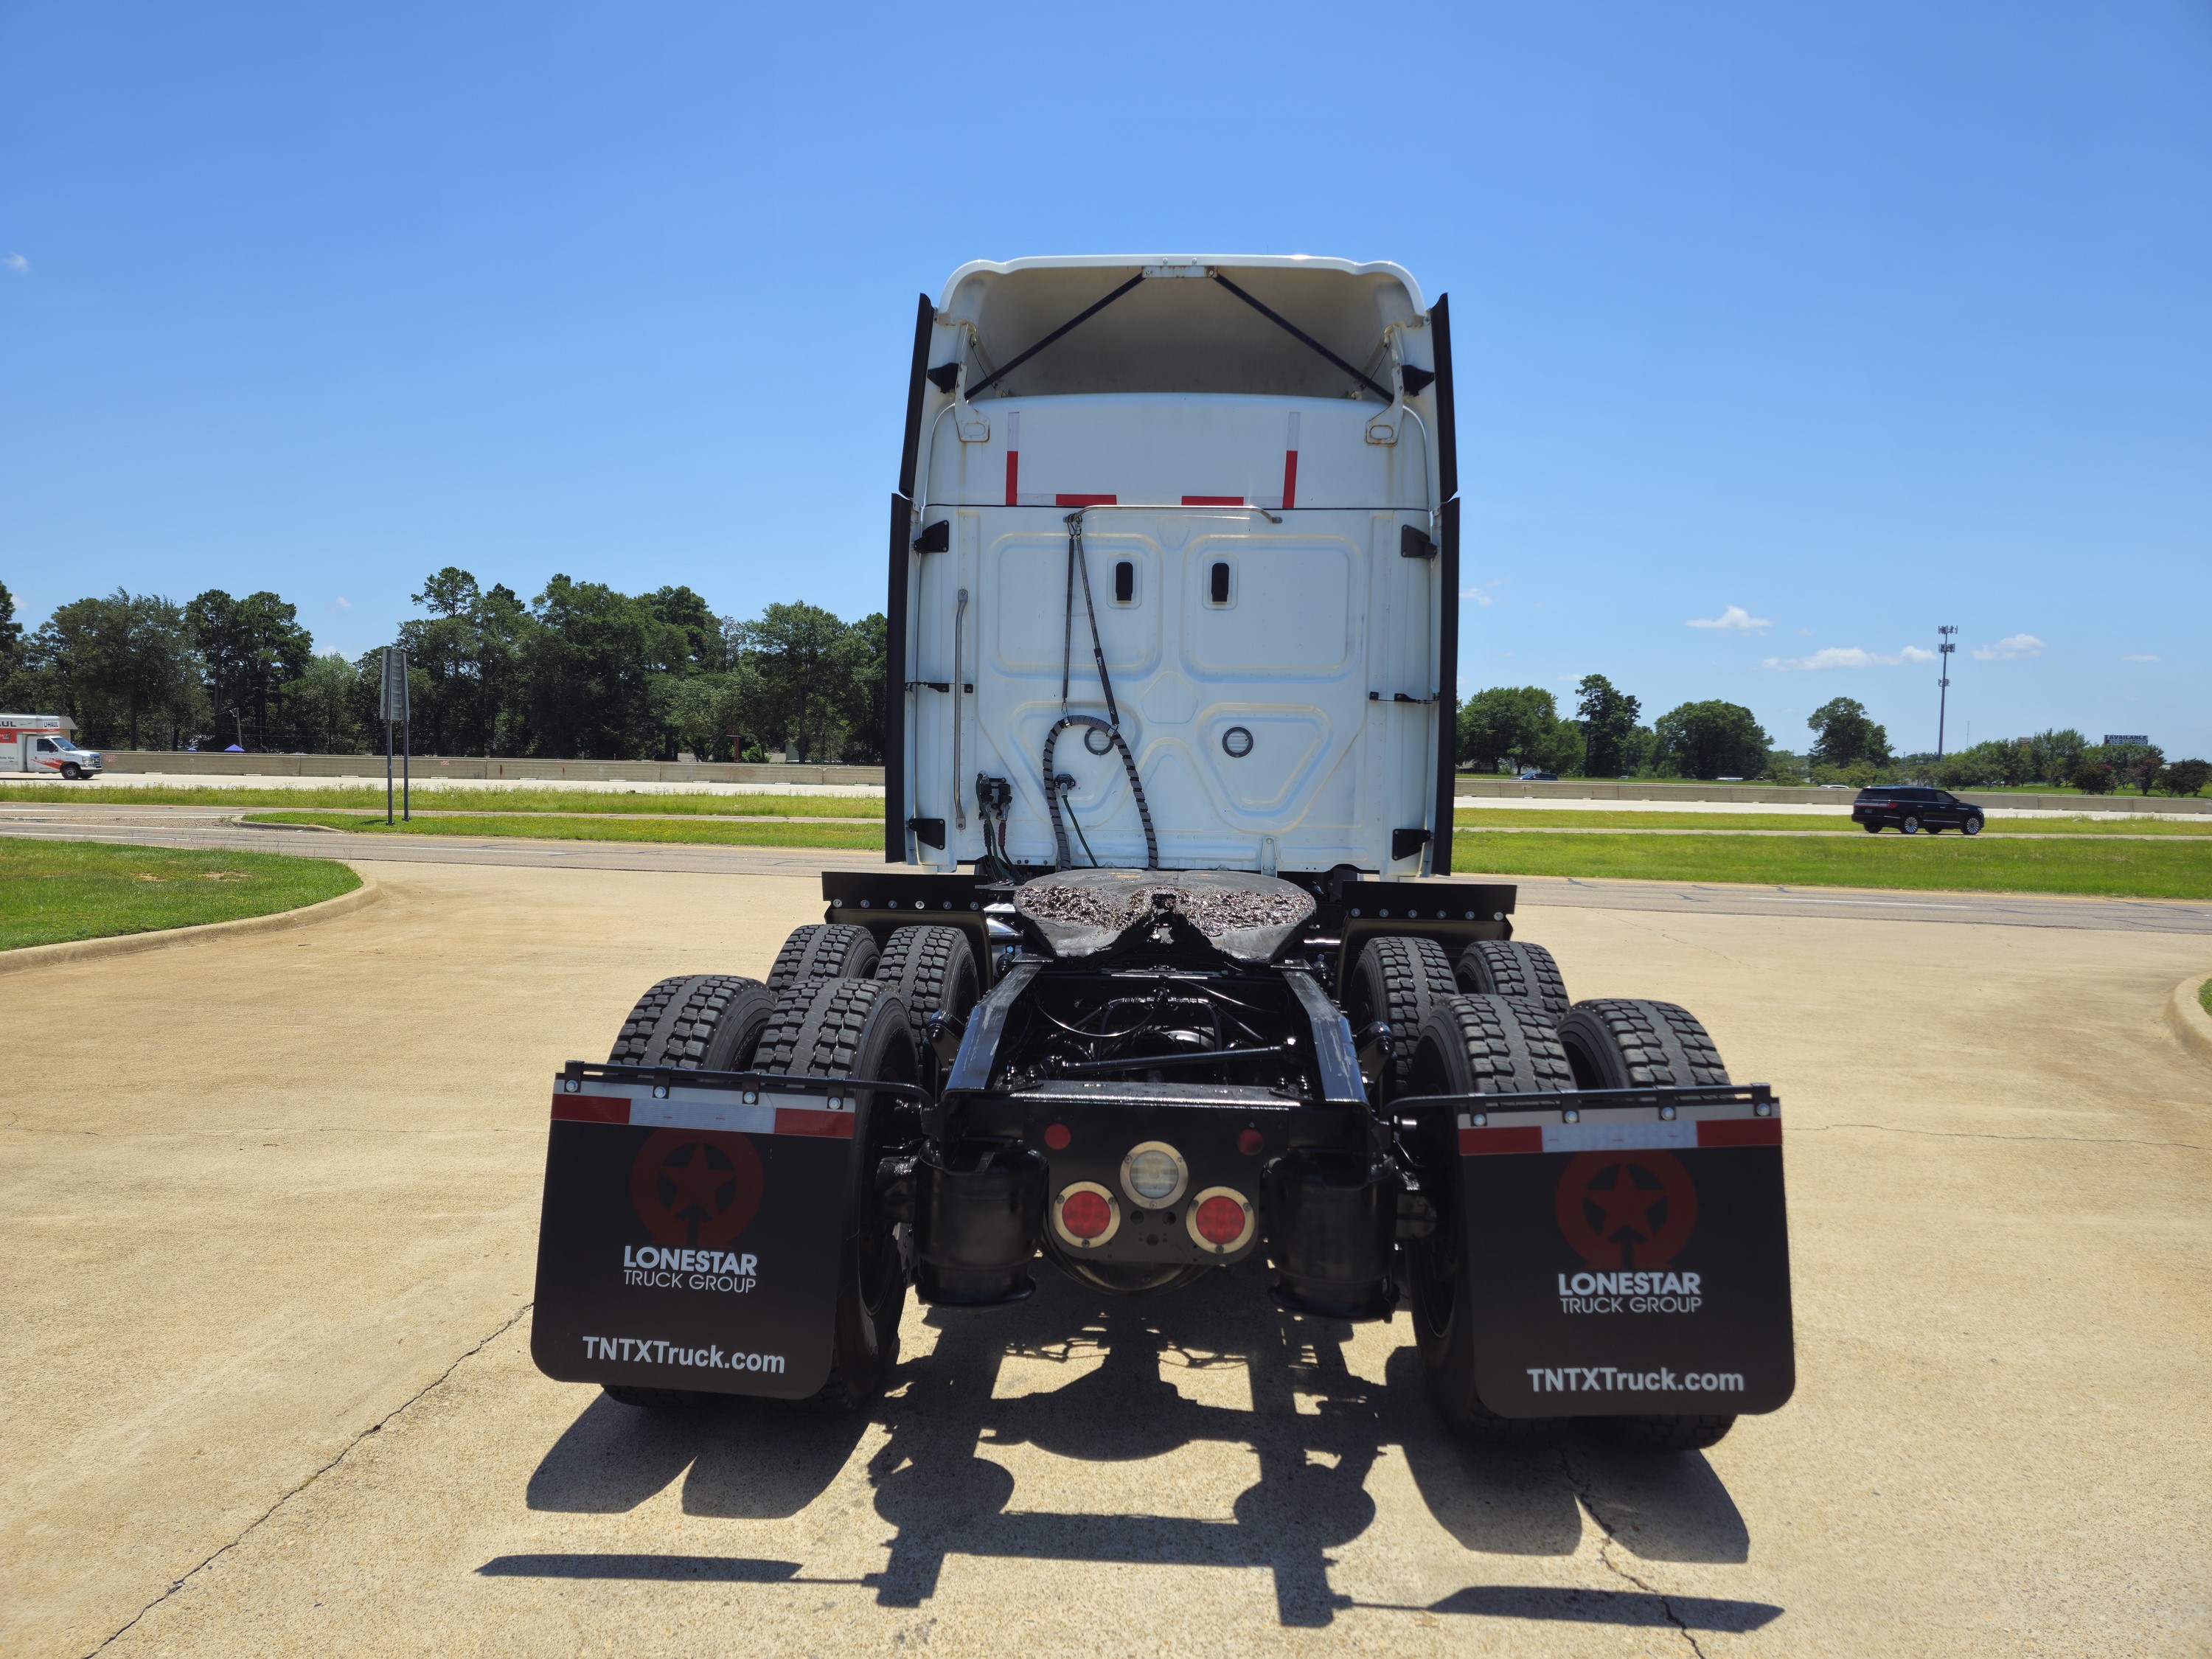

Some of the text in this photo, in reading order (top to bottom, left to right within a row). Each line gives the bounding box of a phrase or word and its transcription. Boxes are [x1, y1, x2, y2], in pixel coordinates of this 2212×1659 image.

[623, 1245, 758, 1276] LONESTAR
[623, 1269, 757, 1294] TRUCK GROUP
[1558, 1271, 1702, 1296] LONESTAR
[1559, 1296, 1703, 1314] TRUCK GROUP
[582, 1335, 785, 1374] TNTXTruck.com
[1526, 1366, 1745, 1393] TNTXTruck.com
